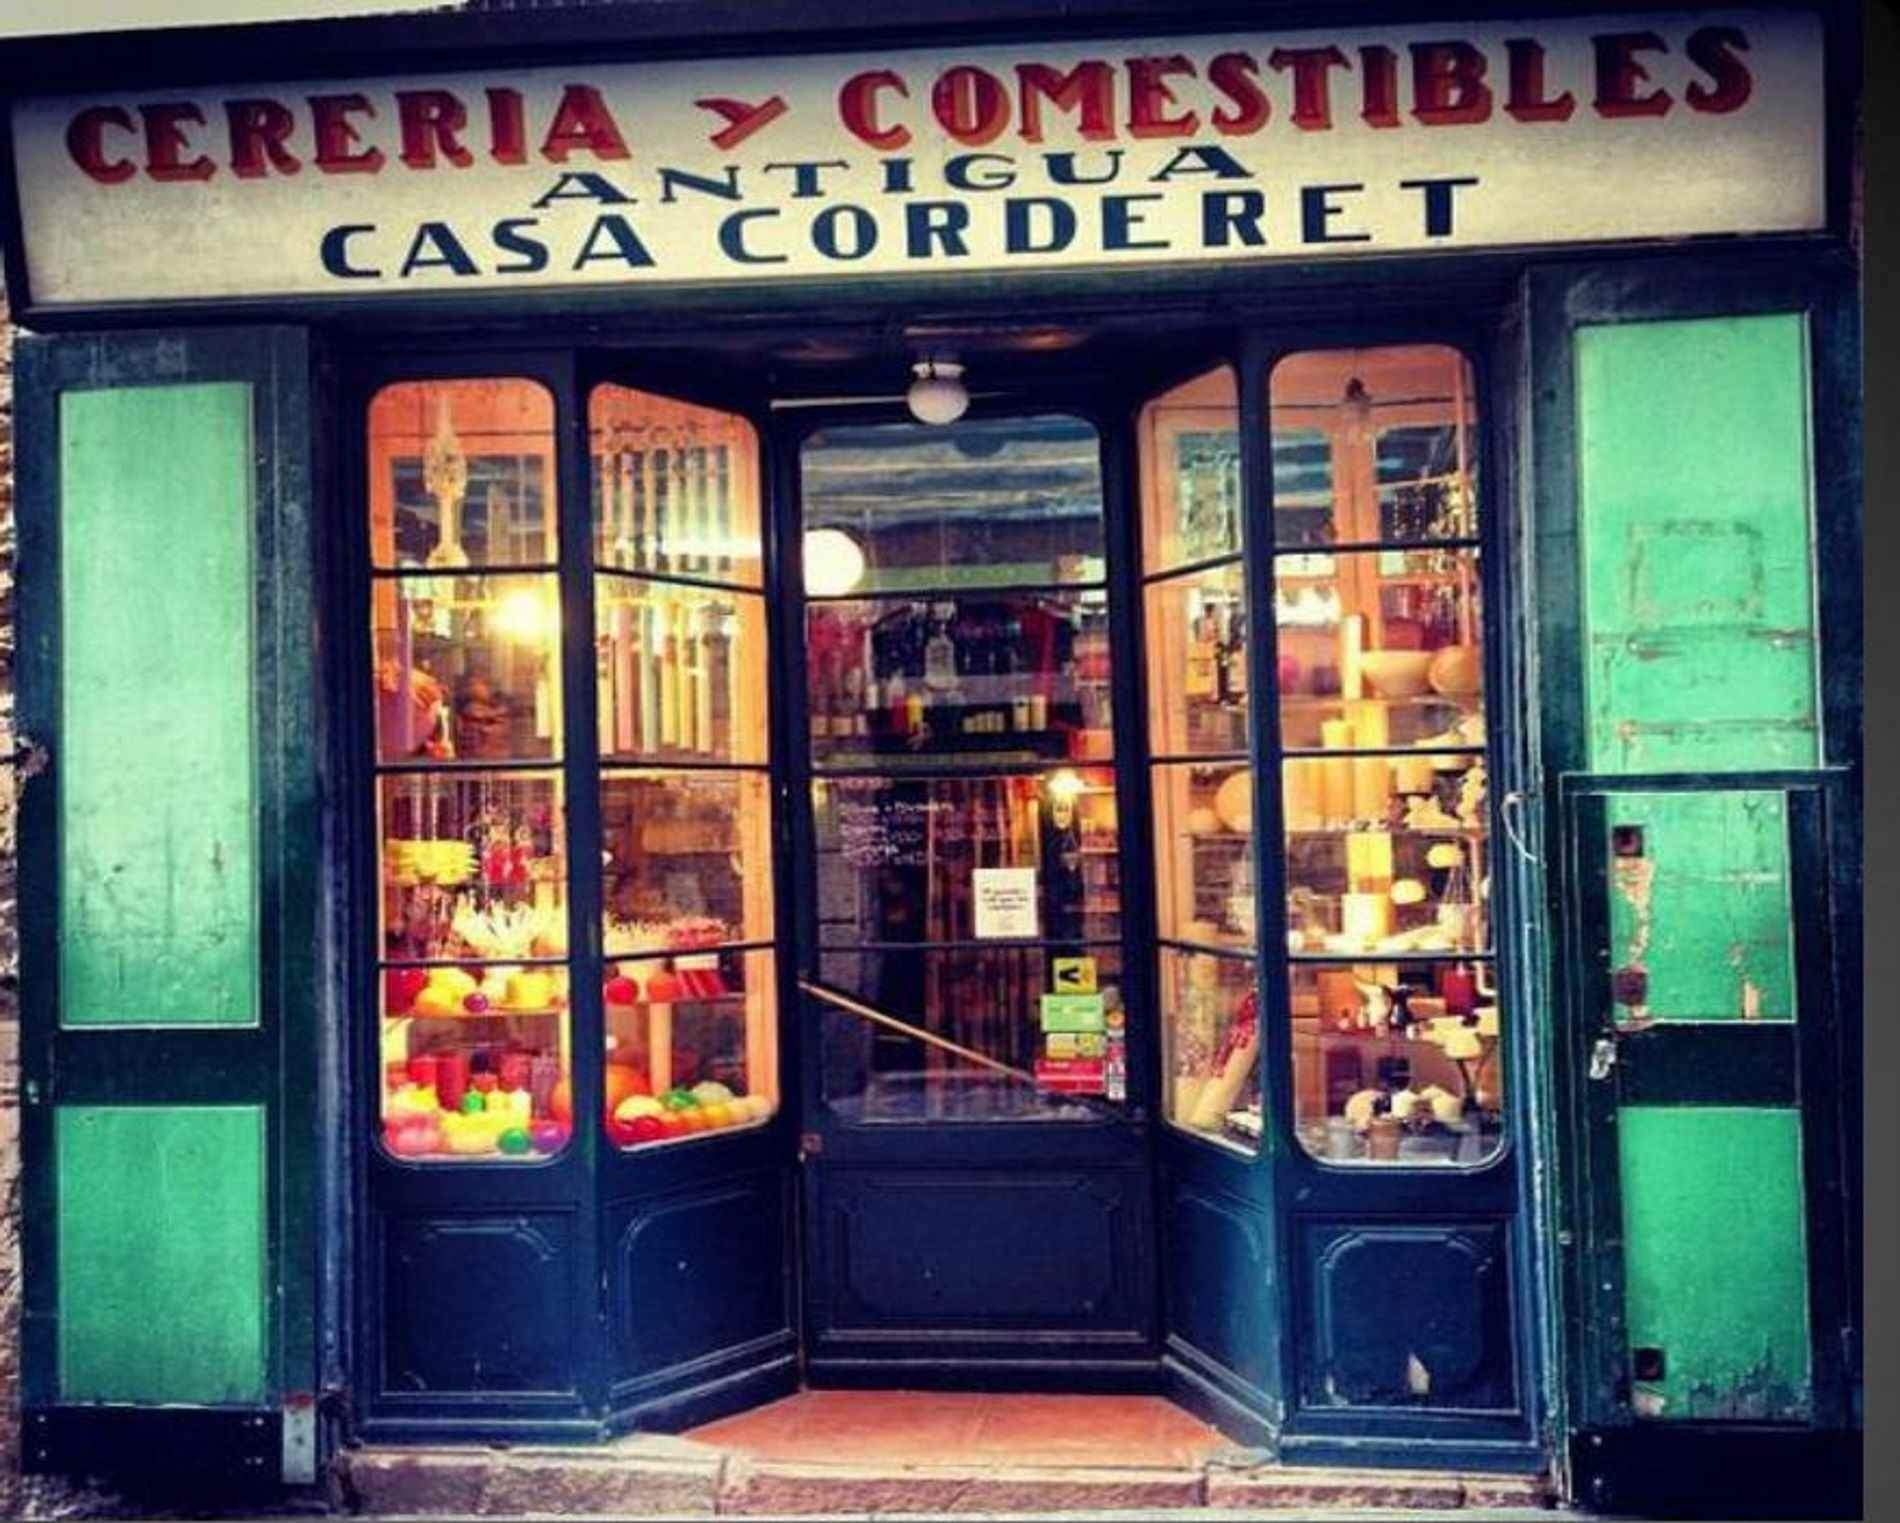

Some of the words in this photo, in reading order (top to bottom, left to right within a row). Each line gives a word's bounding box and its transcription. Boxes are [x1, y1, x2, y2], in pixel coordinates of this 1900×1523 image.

[66, 84, 632, 185] CERERIA
[838, 26, 1752, 151] COMESTIBLES
[532, 145, 1255, 208] ANTIGUA
[320, 214, 655, 278] CASA
[718, 178, 1479, 264] CORDERET
